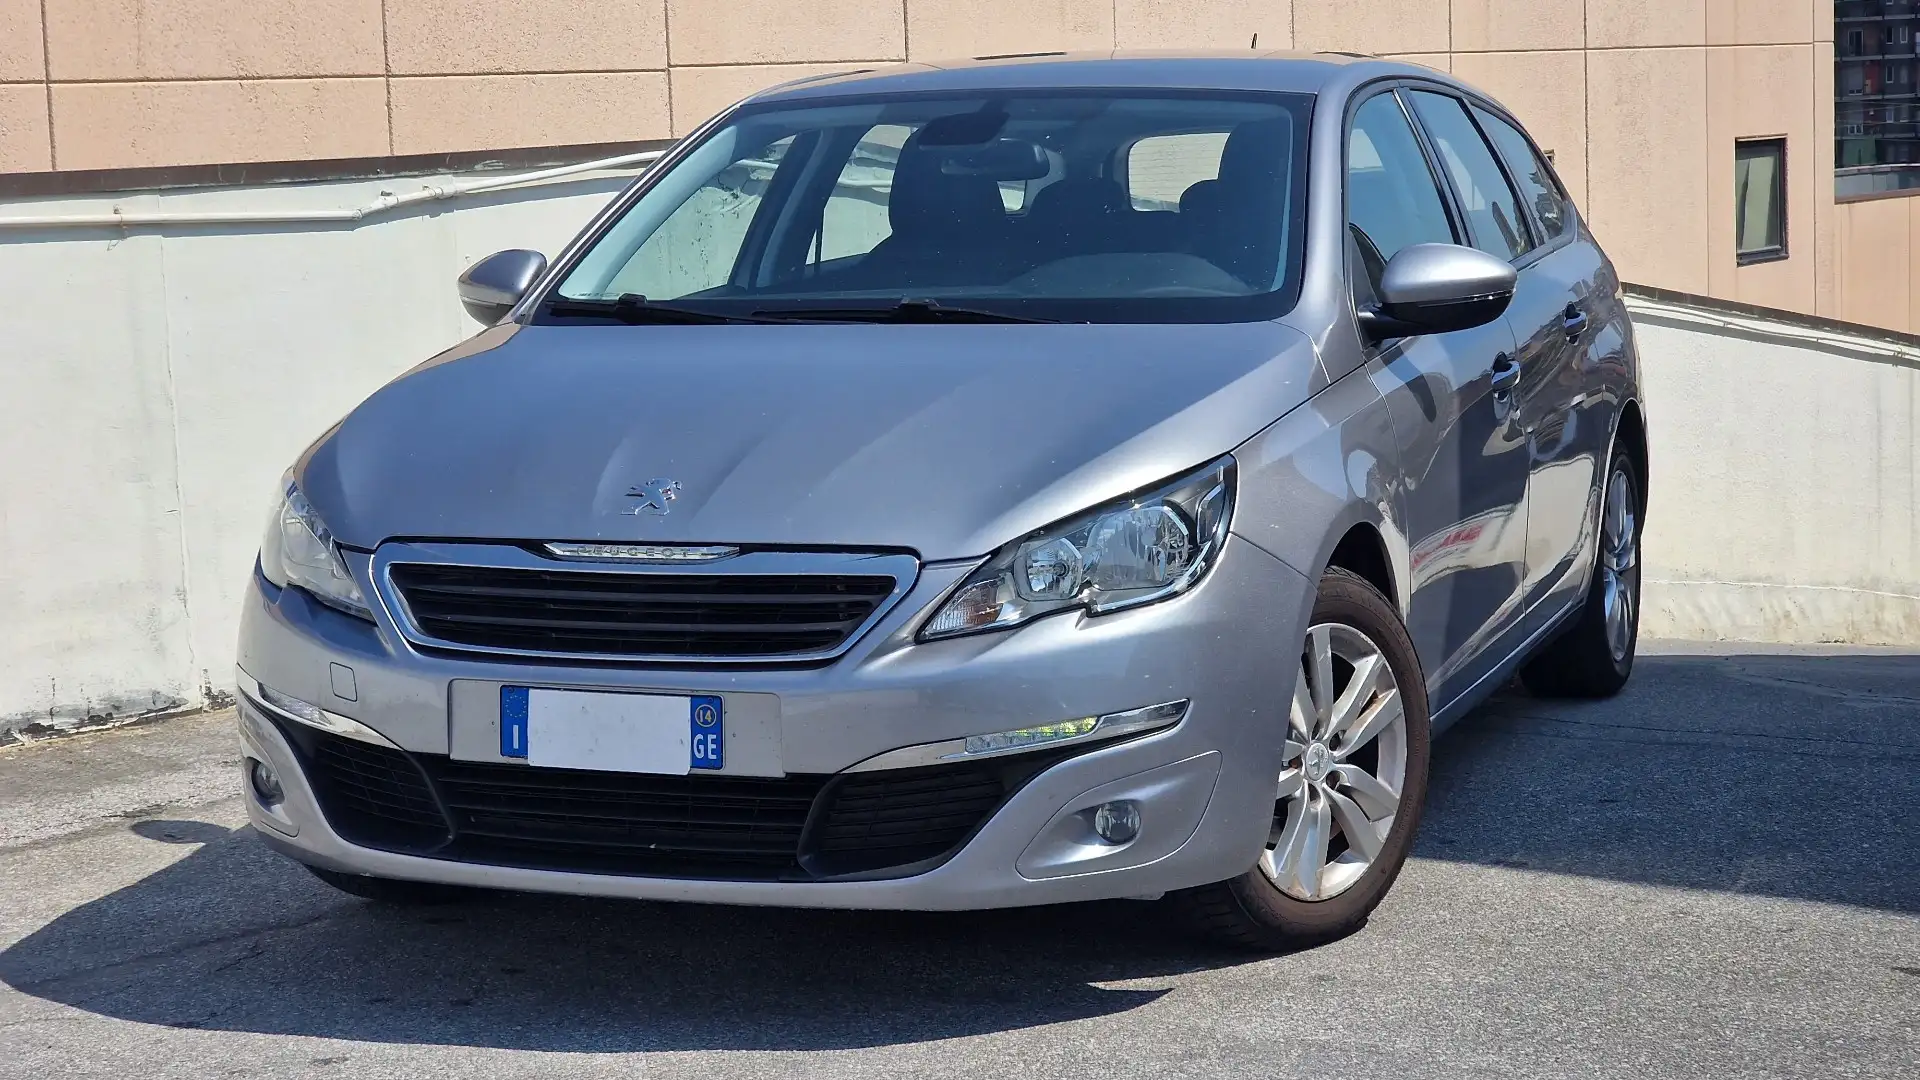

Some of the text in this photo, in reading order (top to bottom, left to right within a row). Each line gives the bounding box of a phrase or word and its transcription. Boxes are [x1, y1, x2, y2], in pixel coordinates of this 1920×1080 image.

[576, 545, 691, 558] PEUGEOT
[699, 709, 712, 723] 14
[512, 724, 519, 749] I
[693, 733, 717, 760] GE
